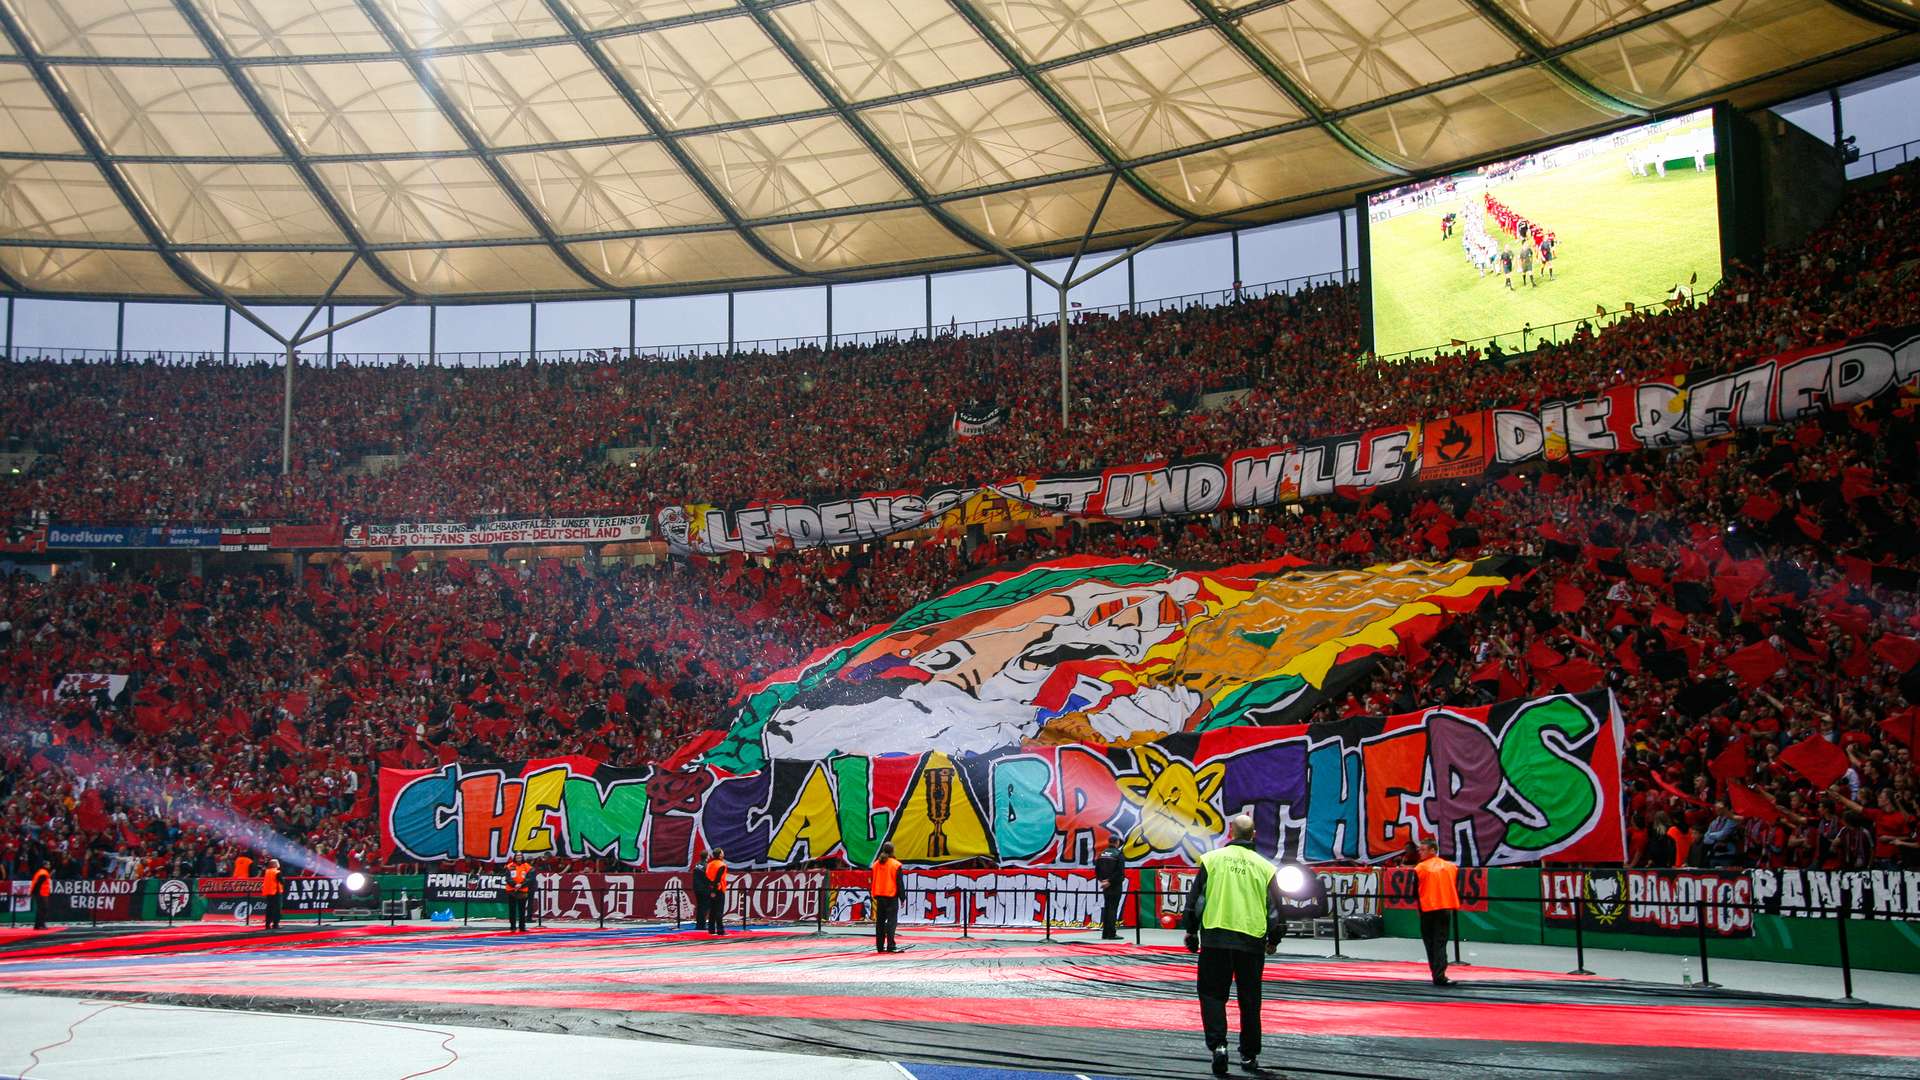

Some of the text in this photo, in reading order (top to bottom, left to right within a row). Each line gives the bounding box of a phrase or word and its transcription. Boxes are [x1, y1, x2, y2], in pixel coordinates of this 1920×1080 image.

[1369, 209, 1392, 224] HDI
[1104, 462, 1226, 519] UND
[1233, 430, 1411, 506] WILLE
[1493, 398, 1618, 462] DIE
[562, 517, 589, 528] UNSER
[50, 530, 124, 543] Nordkurve
[371, 534, 406, 546] BAYER
[391, 755, 895, 873] CHEMICAL
[287, 879, 343, 900] ANDY
[437, 890, 497, 899] LEVERKUSEN
[70, 895, 116, 910] ERBEN
[1542, 873, 1583, 917] LEV
[1627, 873, 1749, 932] BANDITOS
